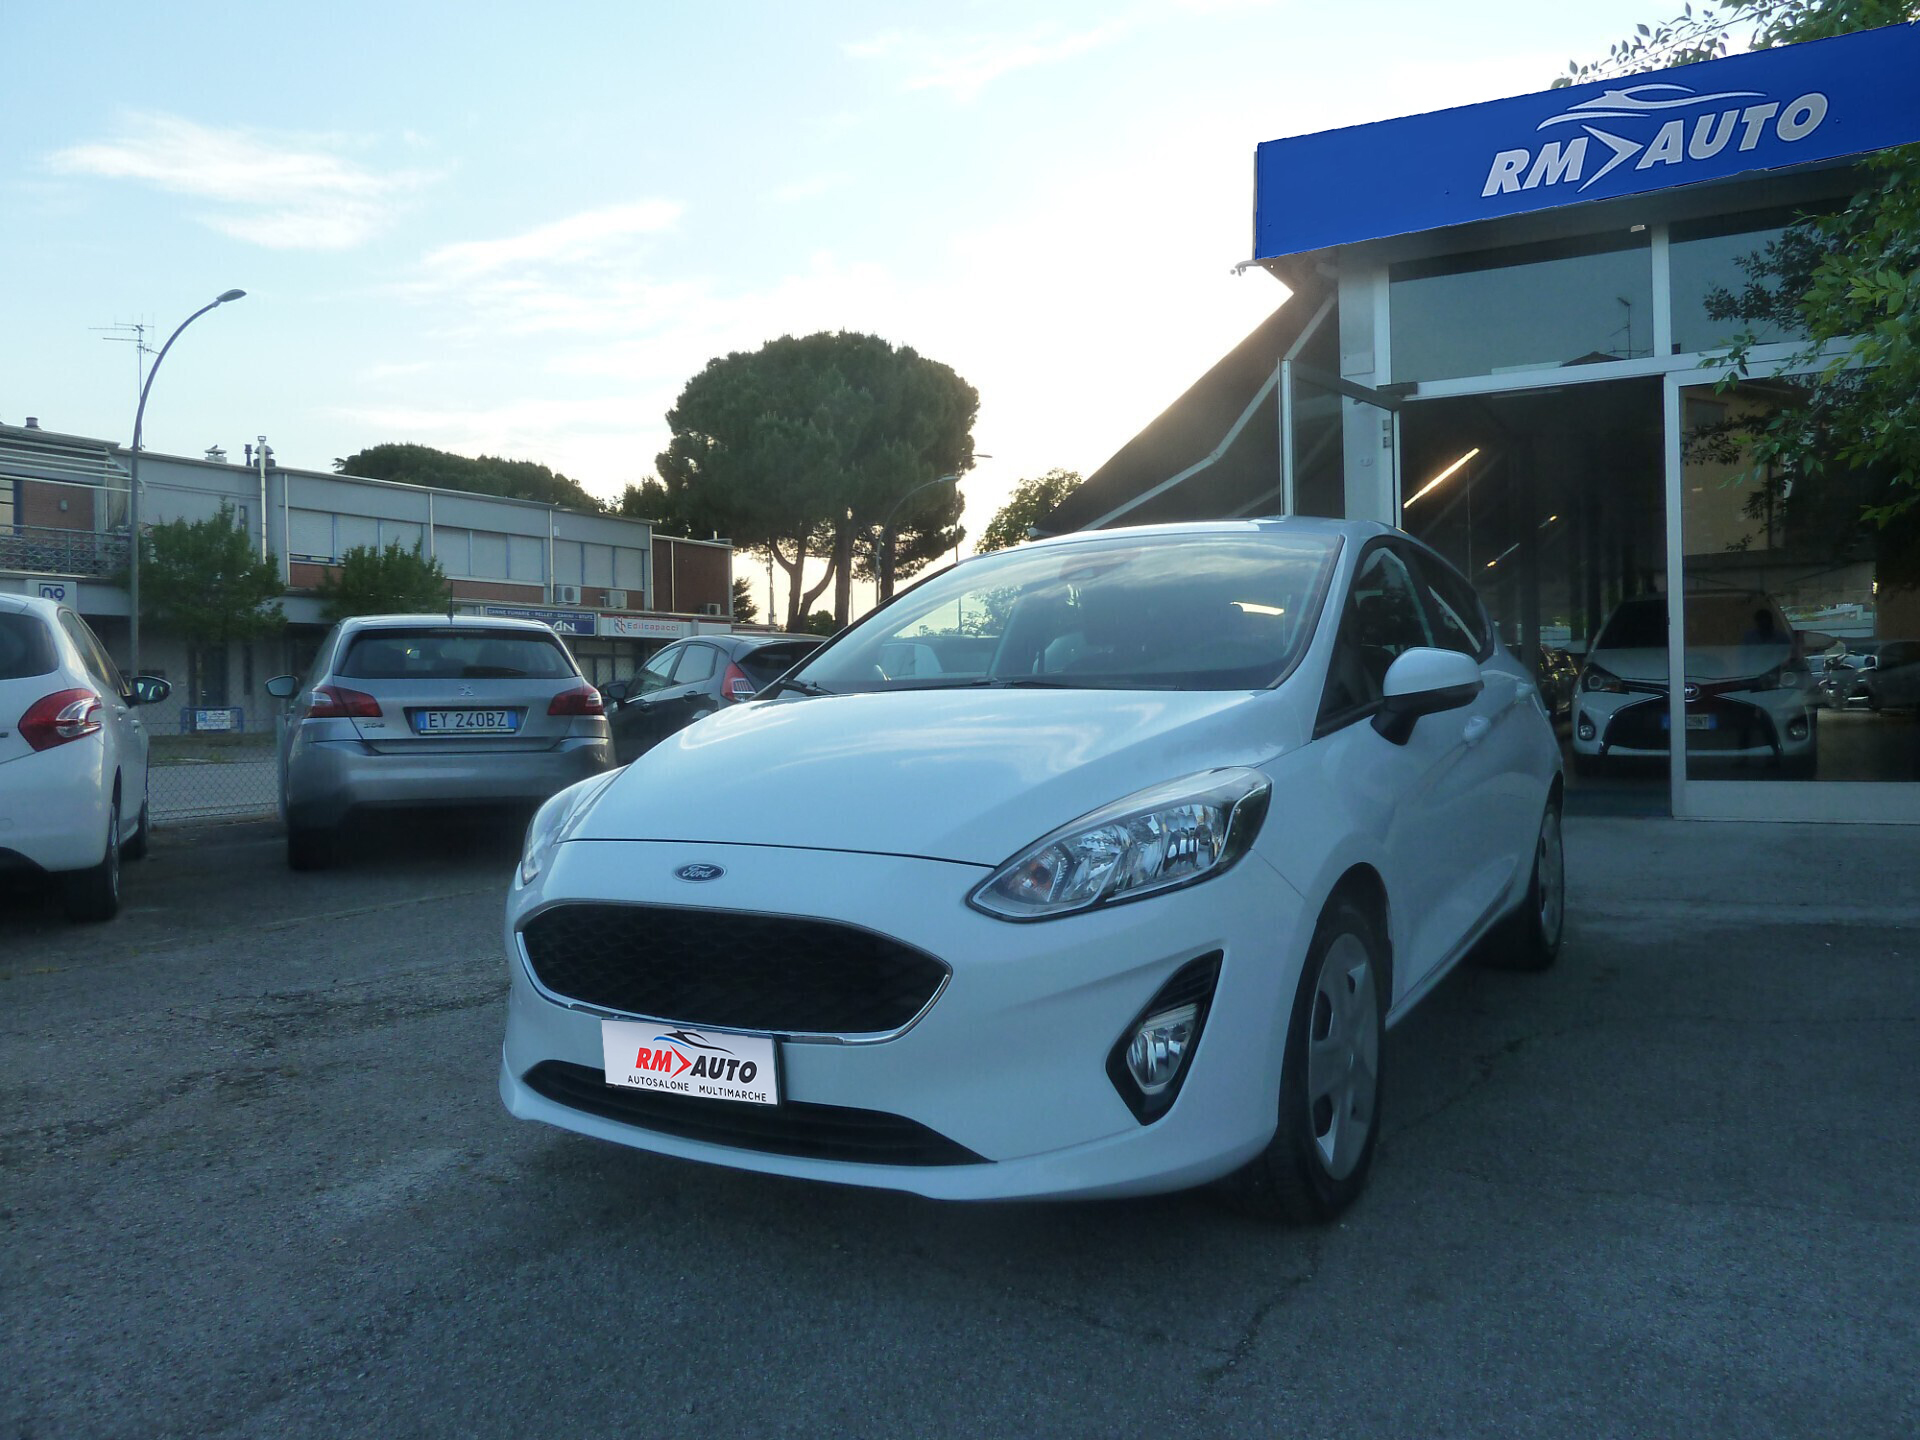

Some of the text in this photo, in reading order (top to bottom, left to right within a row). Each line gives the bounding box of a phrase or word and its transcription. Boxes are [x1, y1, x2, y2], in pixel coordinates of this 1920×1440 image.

[1635, 92, 1828, 170] AUTO
[627, 622, 679, 632] Edilcapacci
[428, 711, 506, 728] EY 240BZ
[682, 864, 715, 878] Ford
[690, 1055, 757, 1084] AUTO
[628, 1074, 767, 1102] AUTOSALONE MULTIMARCHE
